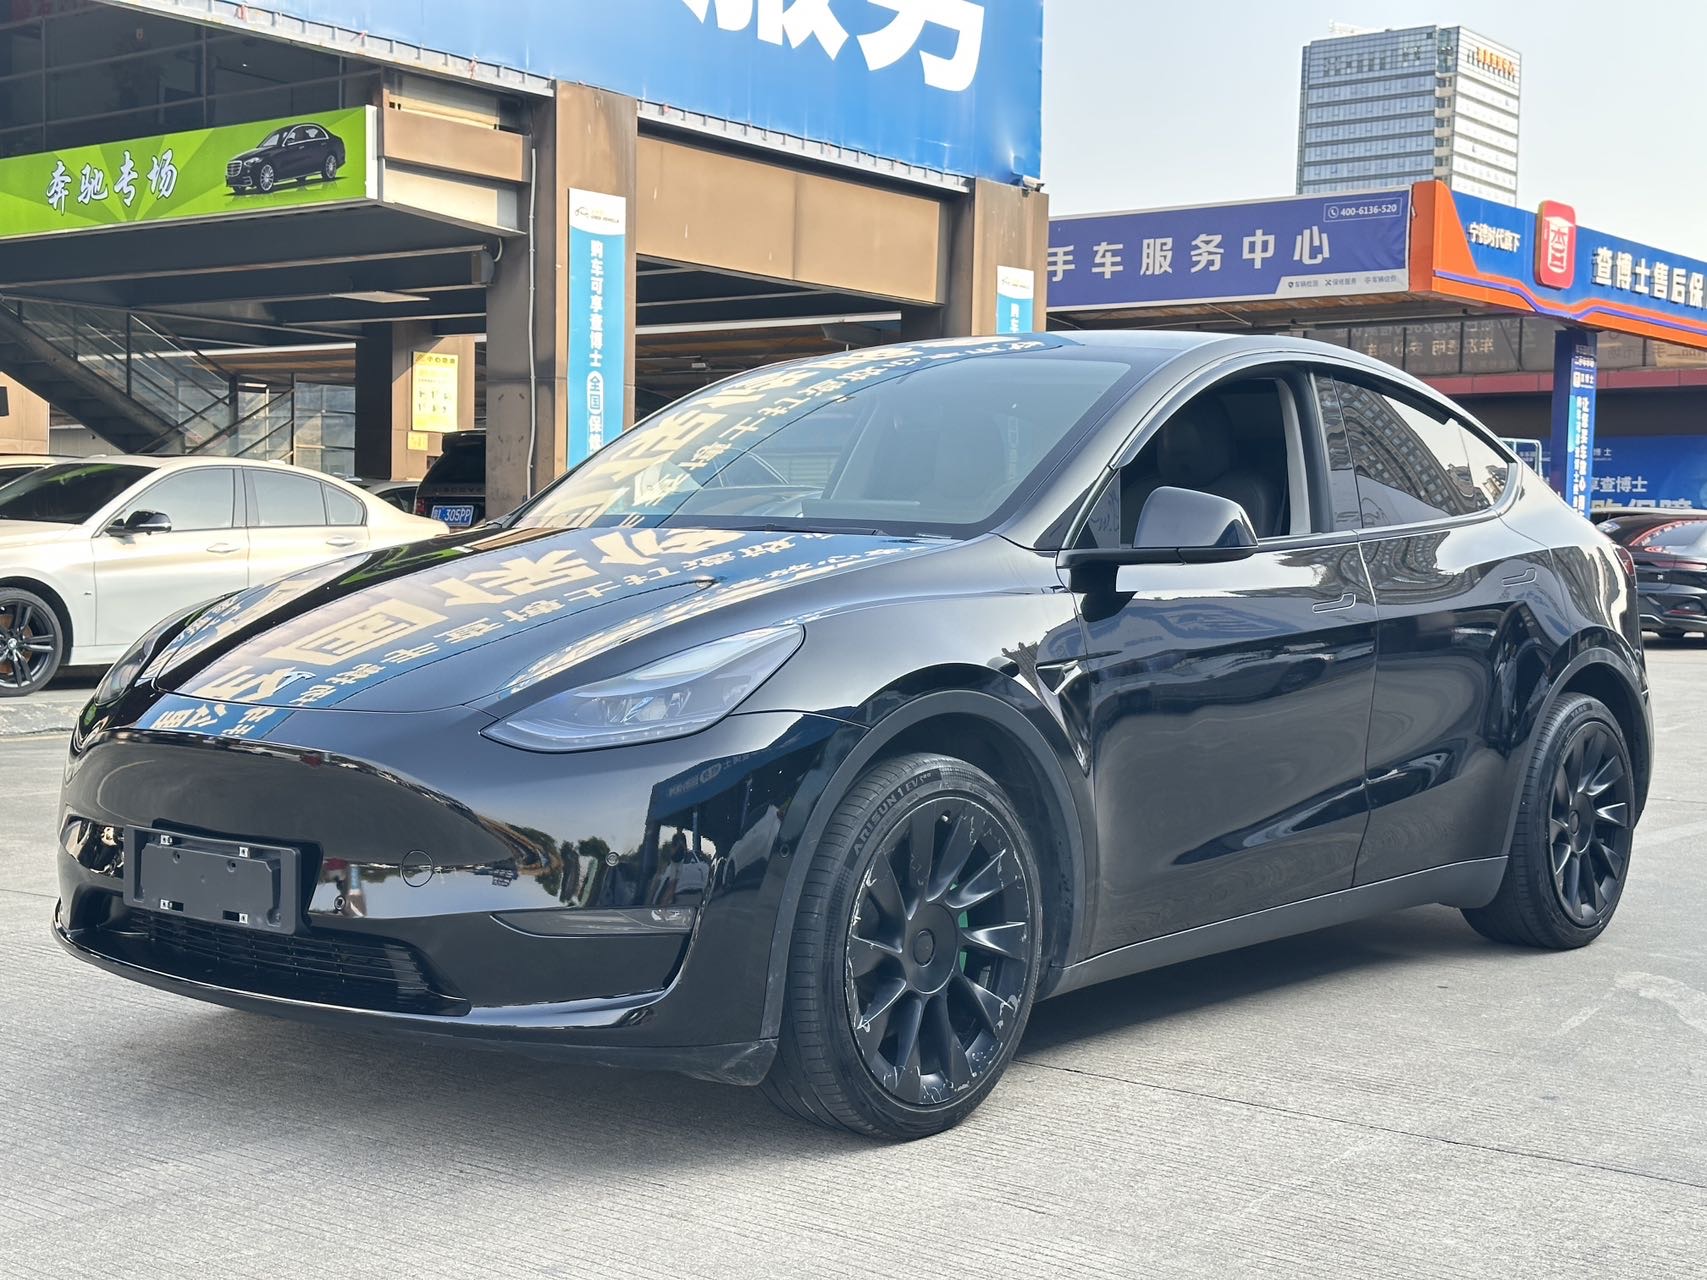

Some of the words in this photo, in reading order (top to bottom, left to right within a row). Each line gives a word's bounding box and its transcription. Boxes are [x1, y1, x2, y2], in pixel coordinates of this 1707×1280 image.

[46, 148, 178, 216] 奔驰专场
[1340, 203, 1398, 216] 400-6136-520
[1047, 225, 1331, 282] 手车服务中心
